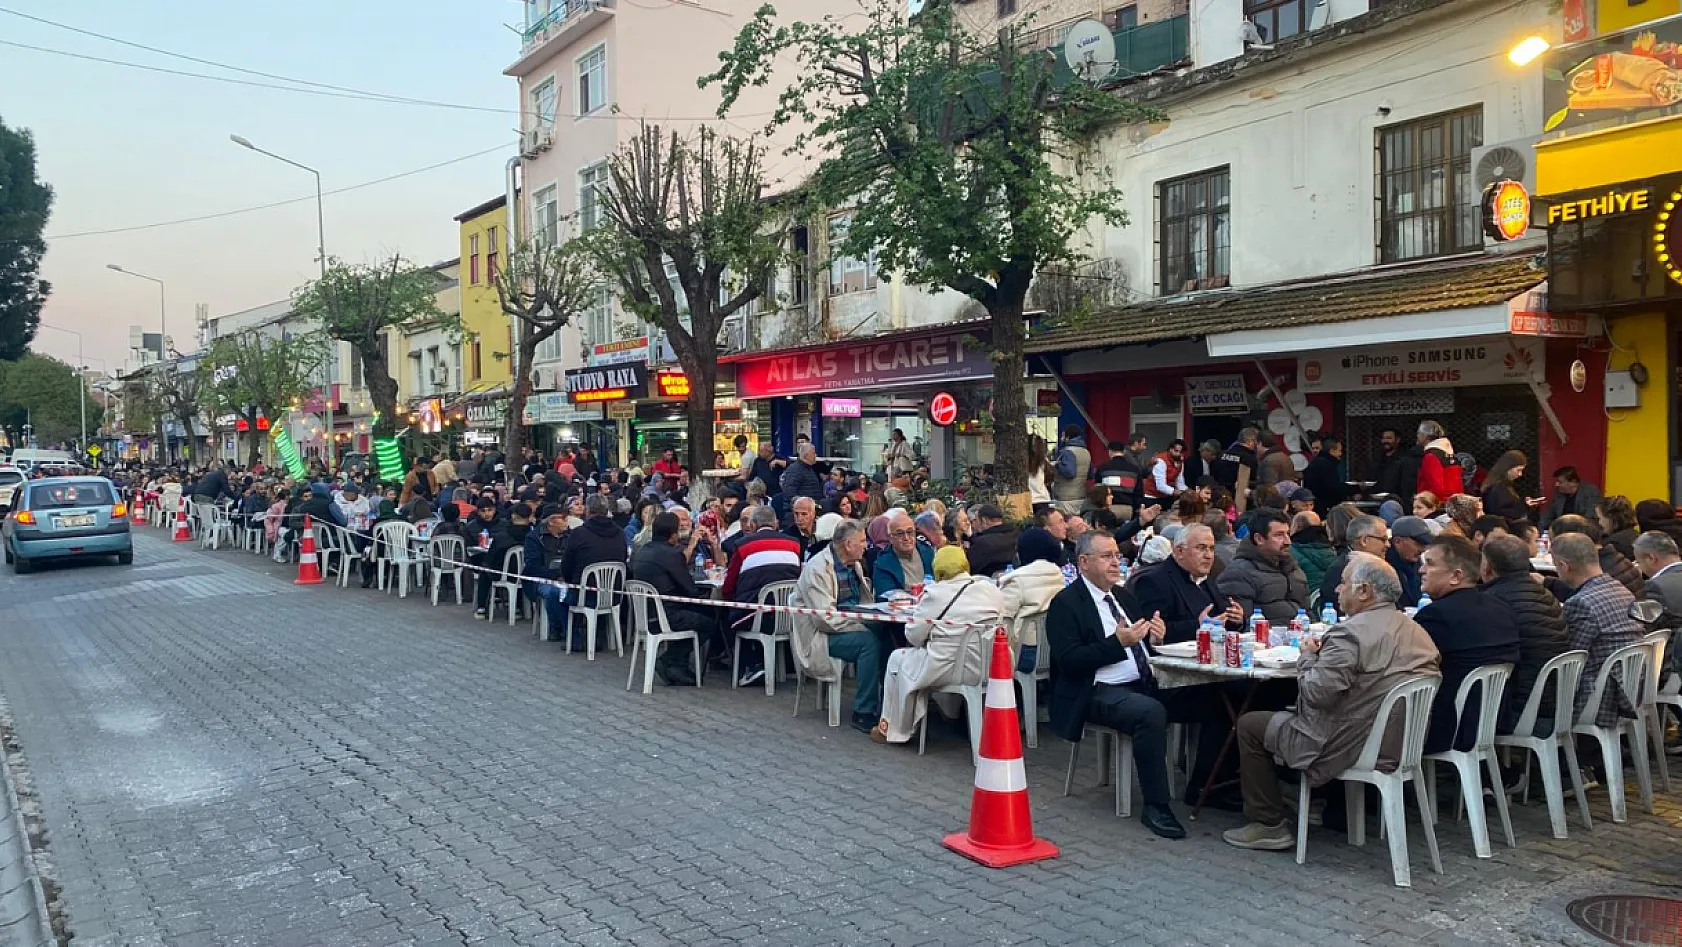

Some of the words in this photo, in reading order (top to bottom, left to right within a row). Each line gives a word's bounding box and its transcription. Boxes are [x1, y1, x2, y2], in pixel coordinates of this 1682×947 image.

[1548, 190, 1649, 223] FETHİYE
[767, 353, 838, 383] ATLAS
[849, 336, 965, 373] TİCARET
[1353, 354, 1399, 368] iPhone
[1408, 347, 1486, 364] SAMSUNG
[1362, 370, 1404, 385] ETKİLİ
[1408, 367, 1461, 383] SERVİS
